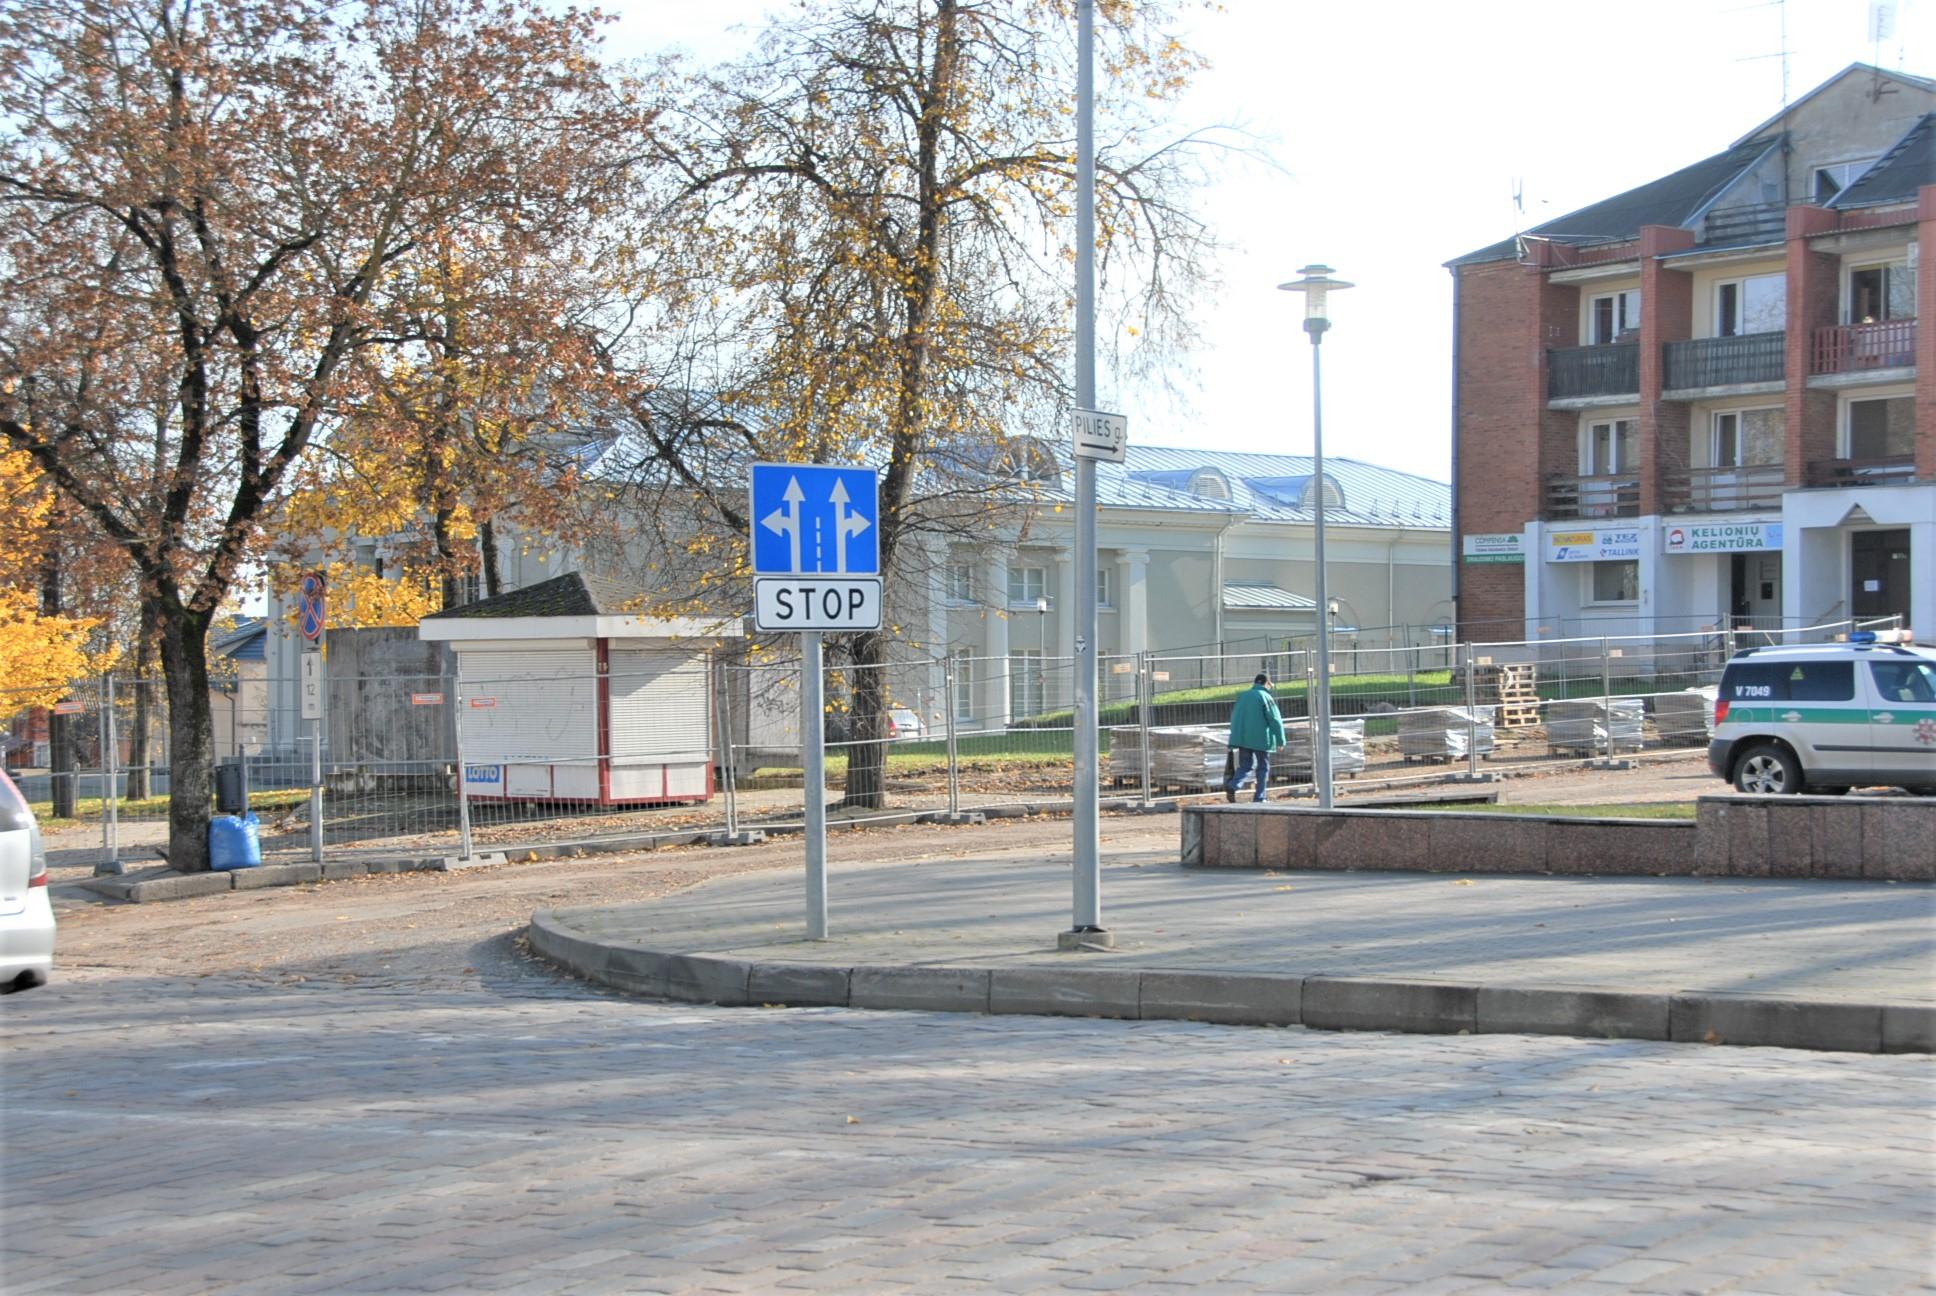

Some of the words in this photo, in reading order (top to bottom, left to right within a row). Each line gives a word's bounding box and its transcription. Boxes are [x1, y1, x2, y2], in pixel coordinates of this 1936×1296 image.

[1075, 415, 1111, 438] PILIES
[1691, 526, 1760, 538] KELIONIŲ
[1691, 538, 1763, 549] AGENTŪRA
[775, 588, 865, 620] STOP
[306, 683, 316, 696] 12
[1735, 686, 1743, 697] V
[1745, 686, 1770, 697] 7049
[468, 766, 497, 778] LOTTO
